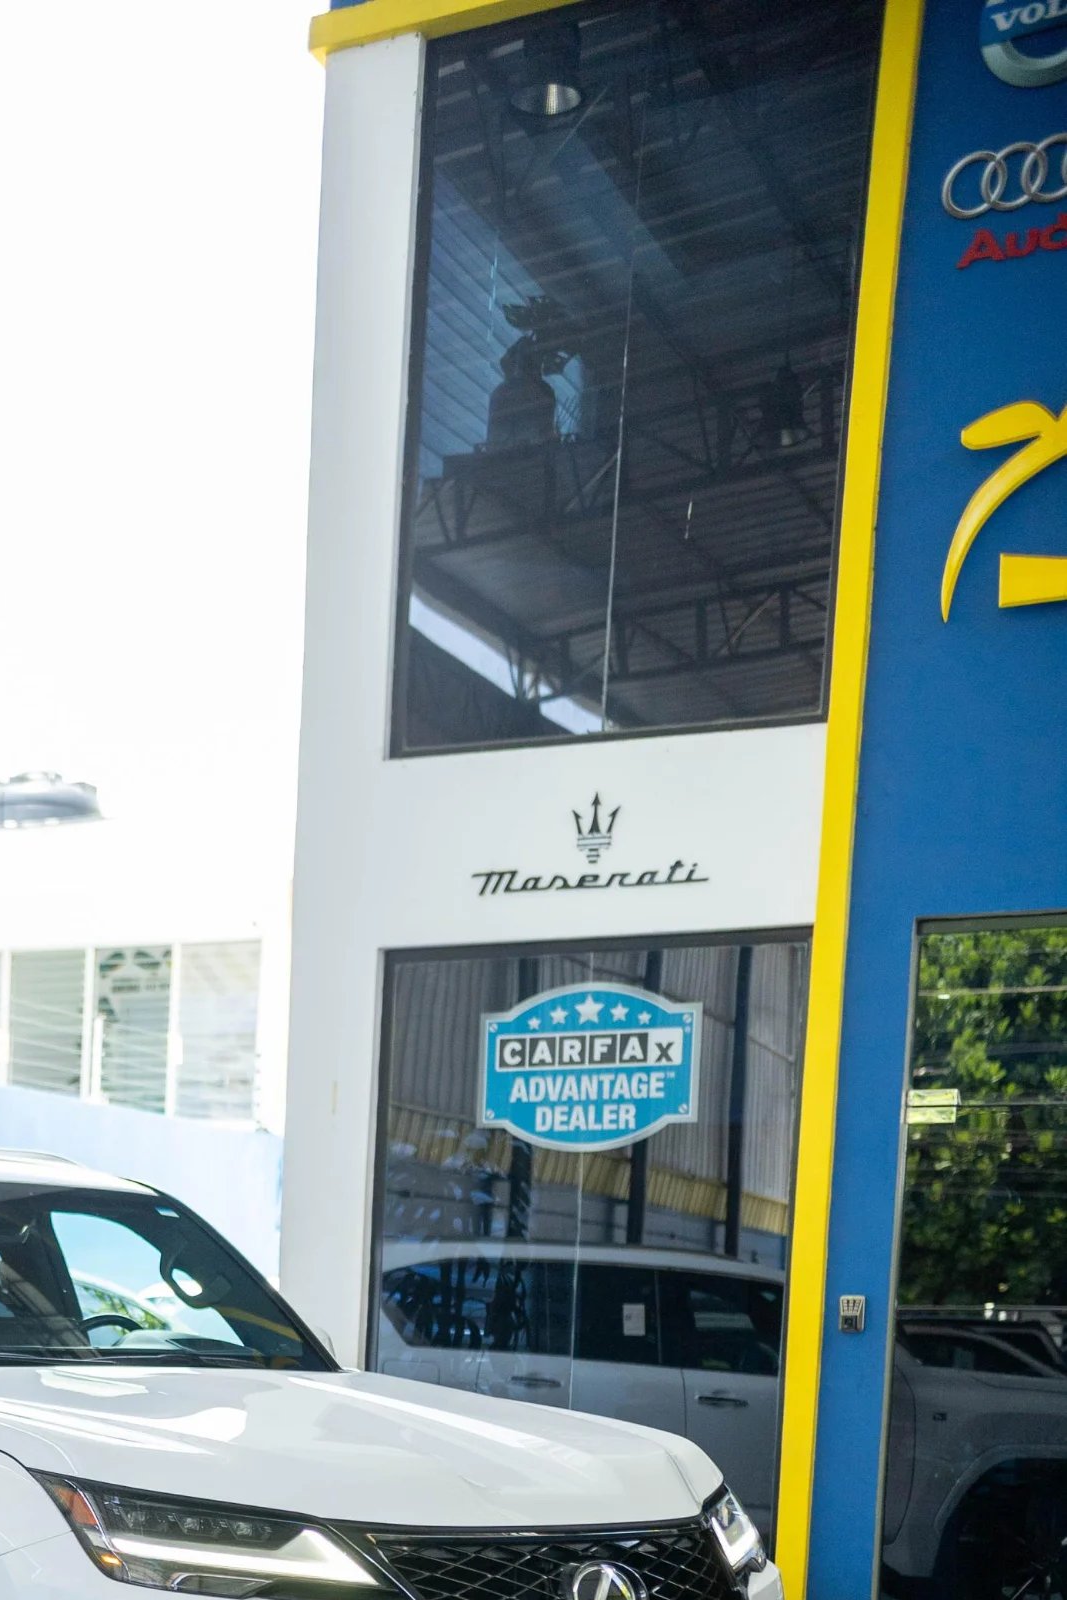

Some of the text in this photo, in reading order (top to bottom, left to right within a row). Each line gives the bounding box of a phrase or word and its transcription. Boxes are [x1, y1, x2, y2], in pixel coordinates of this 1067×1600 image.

[471, 859, 710, 897] Maserati
[501, 1032, 675, 1067] CARFAX
[534, 1103, 637, 1132] DEALER
